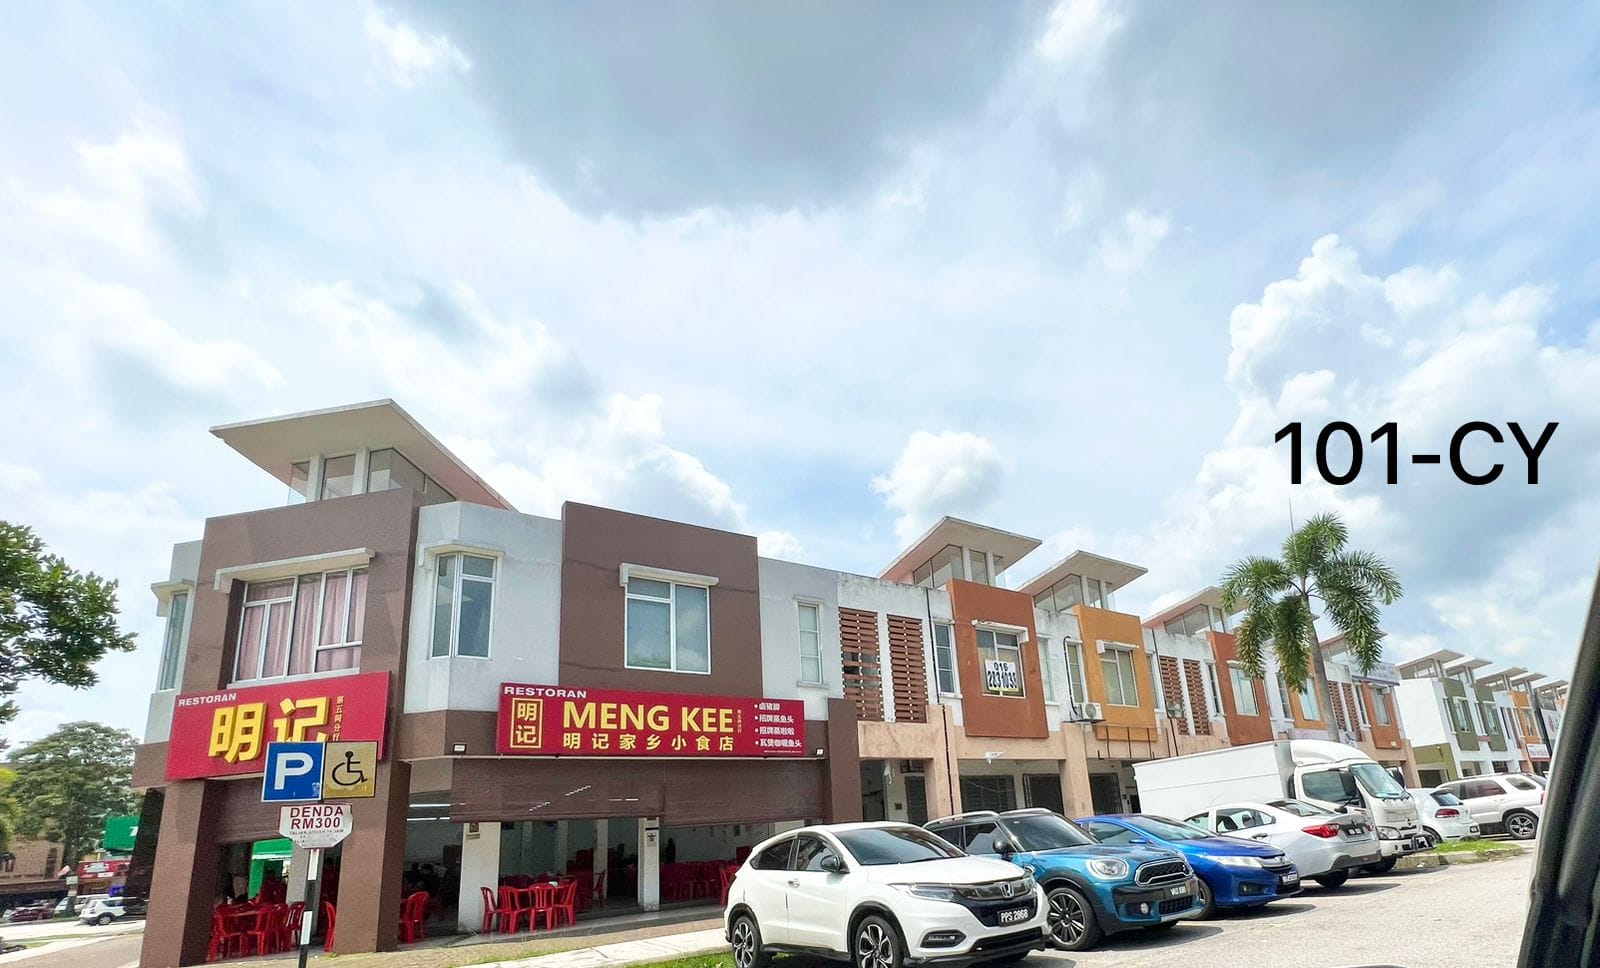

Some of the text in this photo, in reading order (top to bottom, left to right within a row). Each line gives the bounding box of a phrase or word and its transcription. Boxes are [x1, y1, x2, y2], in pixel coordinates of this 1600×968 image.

[178, 693, 237, 707] RESTORAN
[504, 686, 587, 699] RESTORAN
[515, 702, 538, 744] 明记
[563, 701, 670, 732] MENG
[681, 706, 734, 733] KEE
[208, 696, 329, 763] 明记
[274, 752, 314, 790] P
[290, 806, 343, 818] DENDA
[291, 817, 340, 829] RM300
